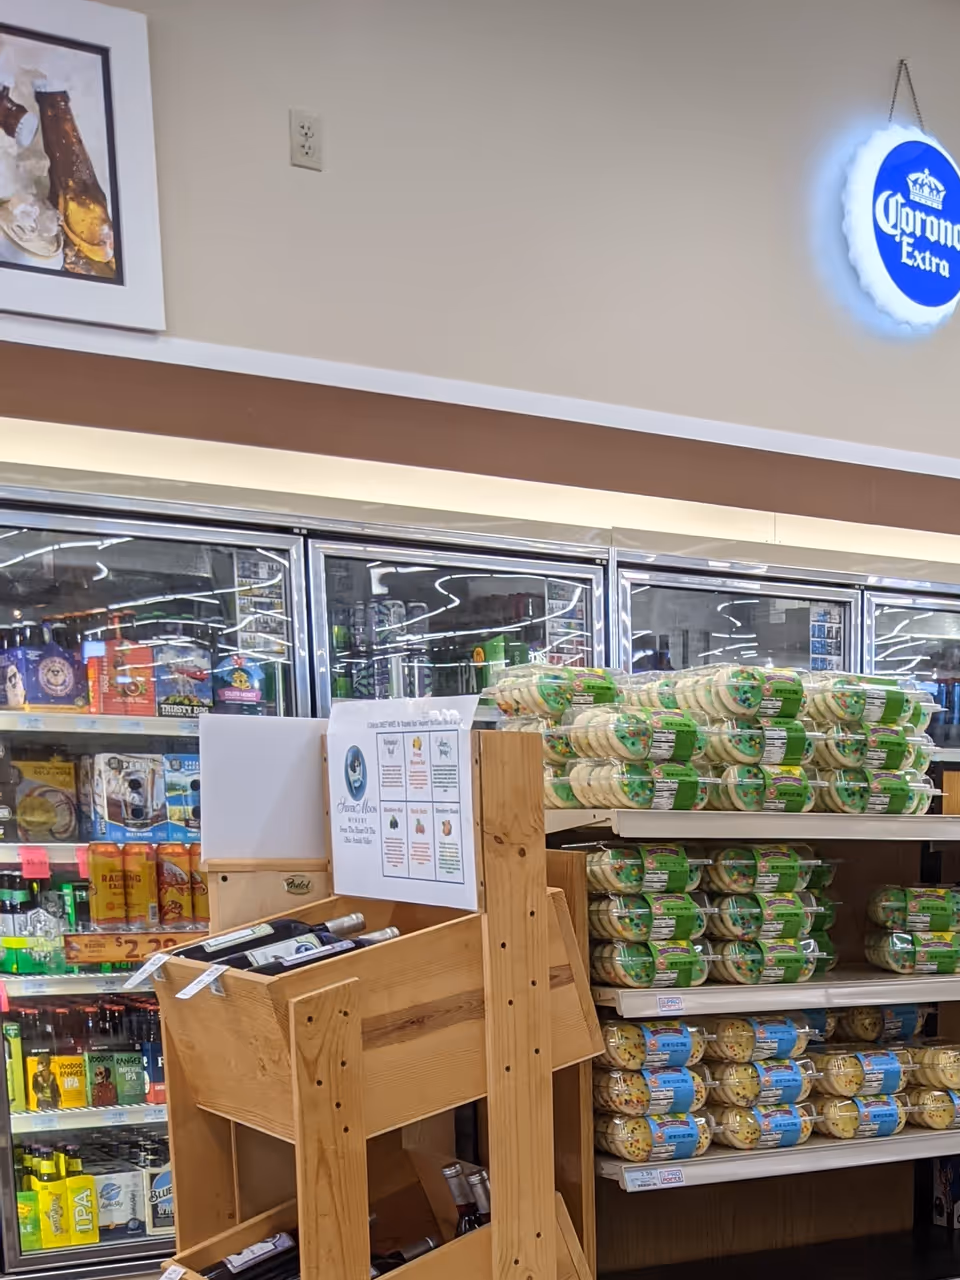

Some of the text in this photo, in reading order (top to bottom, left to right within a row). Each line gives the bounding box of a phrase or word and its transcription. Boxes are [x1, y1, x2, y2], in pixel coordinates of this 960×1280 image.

[901, 234, 950, 278] Extra
[161, 704, 209, 714] THIRSTY DOG
[60, 1062, 83, 1070] VOODOO
[88, 1055, 142, 1066] VOODOO RANGER
[60, 1069, 84, 1078] RANGER
[125, 1072, 137, 1081] IPA
[64, 1077, 79, 1089] IPA
[149, 1186, 173, 1205] BLUE
[74, 1188, 95, 1234] IPA
